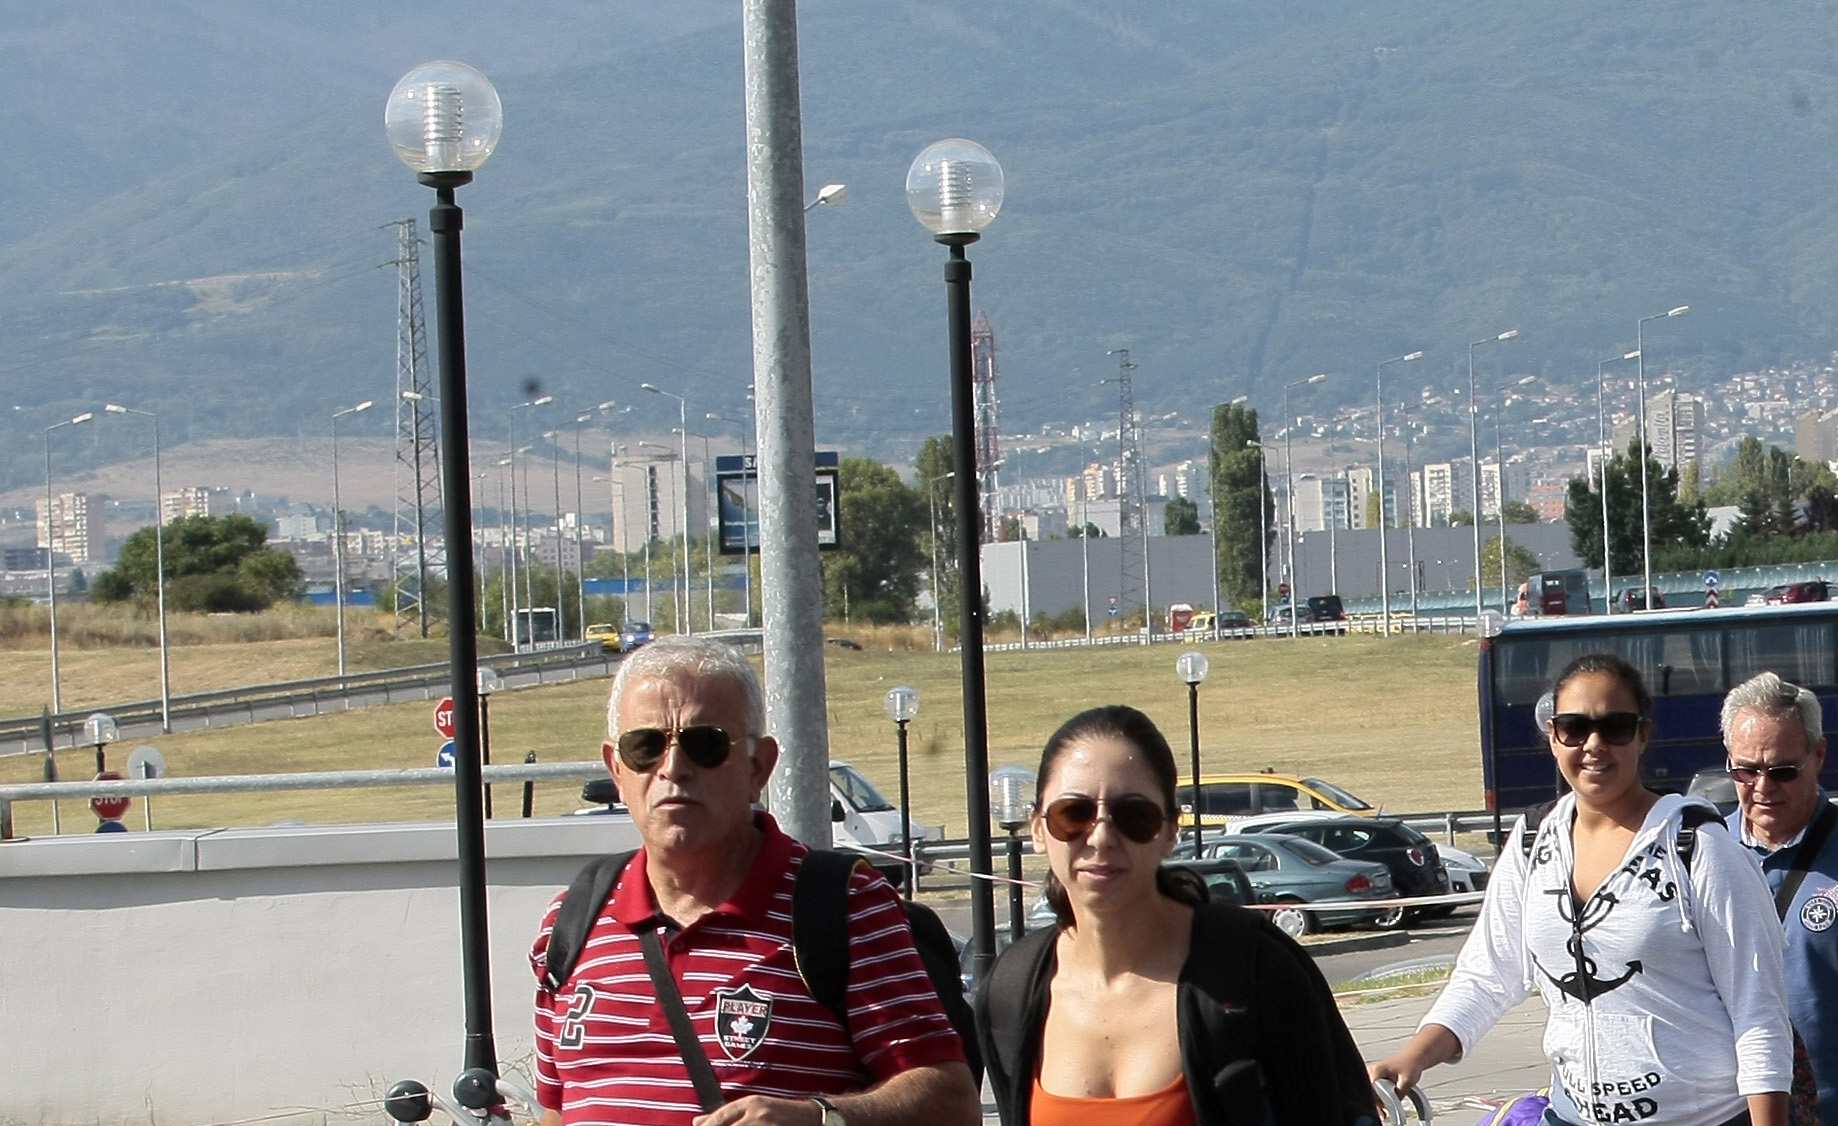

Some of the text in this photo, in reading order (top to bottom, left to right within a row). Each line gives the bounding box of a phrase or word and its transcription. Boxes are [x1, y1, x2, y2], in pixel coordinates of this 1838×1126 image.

[438, 710, 453, 727] ST
[559, 984, 595, 1050] 2
[722, 1001, 769, 1017] PLAYER
[1592, 1071, 1663, 1097] SPEED
